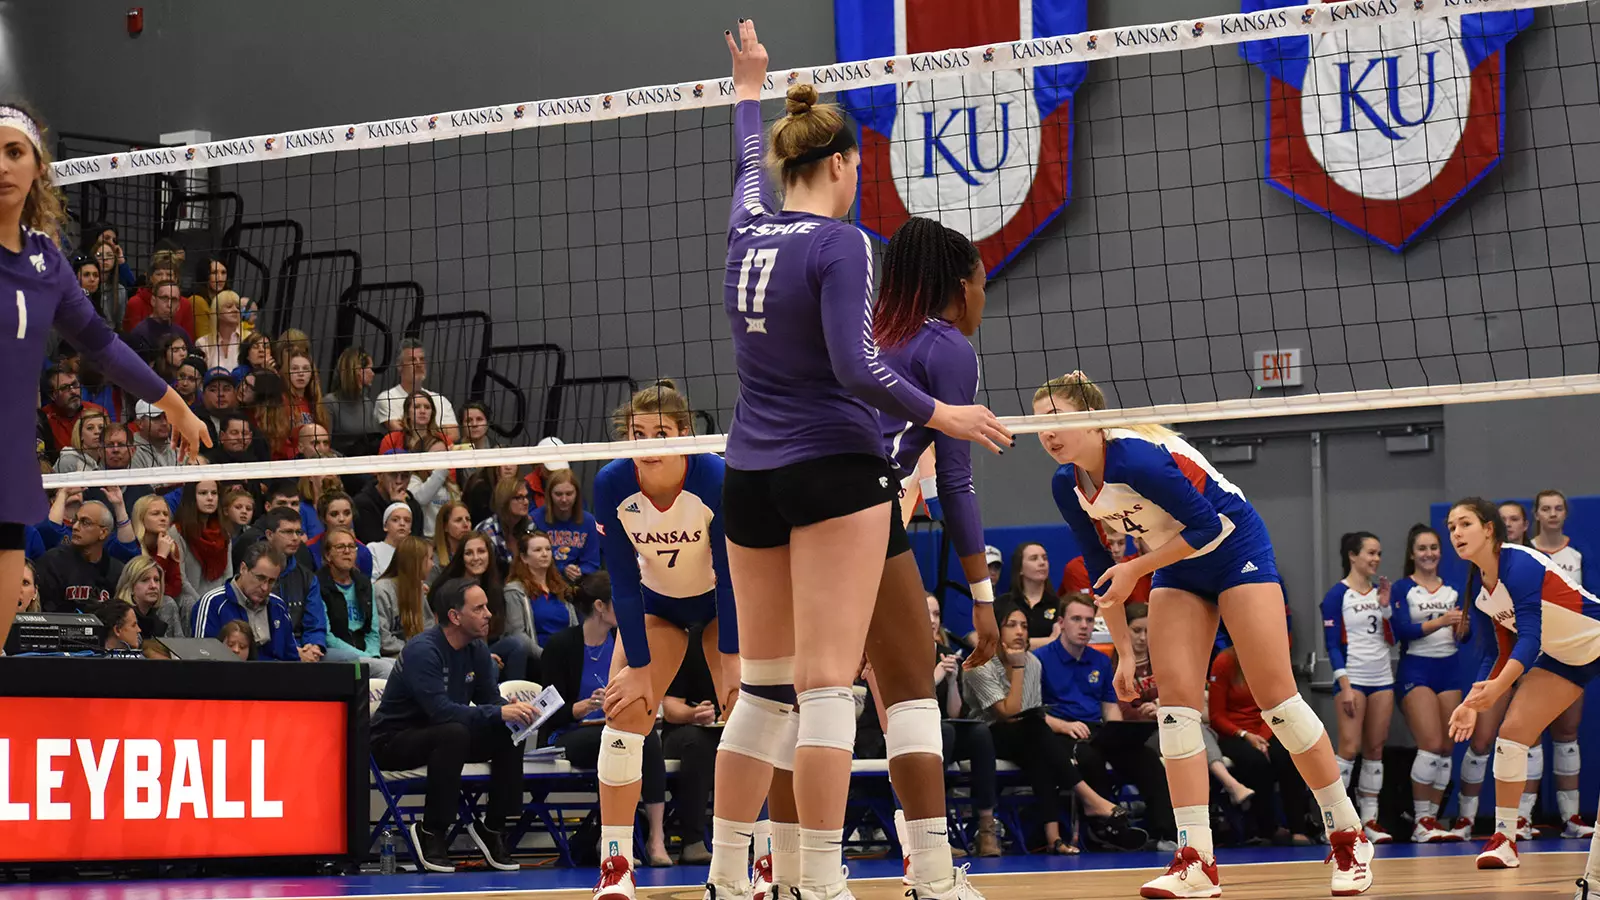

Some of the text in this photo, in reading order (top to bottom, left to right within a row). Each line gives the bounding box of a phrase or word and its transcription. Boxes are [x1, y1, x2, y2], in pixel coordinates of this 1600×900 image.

[55, 159, 100, 178] KANSAS
[130, 150, 177, 169] KANSAS
[205, 139, 255, 159] KANSAS
[285, 129, 335, 149] KANSAS
[368, 119, 418, 139] KANSAS
[450, 107, 503, 127] KANSAS
[538, 98, 591, 118] KANSAS
[626, 87, 682, 107] KANSAS
[812, 62, 871, 85] KANSAS
[911, 51, 970, 72] KANSAS
[1011, 38, 1073, 60] KANSAS
[1114, 25, 1178, 47] KANSAS
[1220, 12, 1287, 34] KANSAS
[1331, 0, 1398, 21] KANSAS
[1332, 50, 1440, 140] KU
[916, 101, 1015, 186] KU
[738, 248, 779, 313] 17
[16, 289, 28, 339] 1
[1262, 353, 1292, 381] EXIT
[631, 530, 702, 545] KANSAS
[1122, 517, 1149, 534] 4
[656, 549, 680, 569] 7
[1353, 602, 1381, 614] KANSA
[1367, 614, 1377, 634] 3
